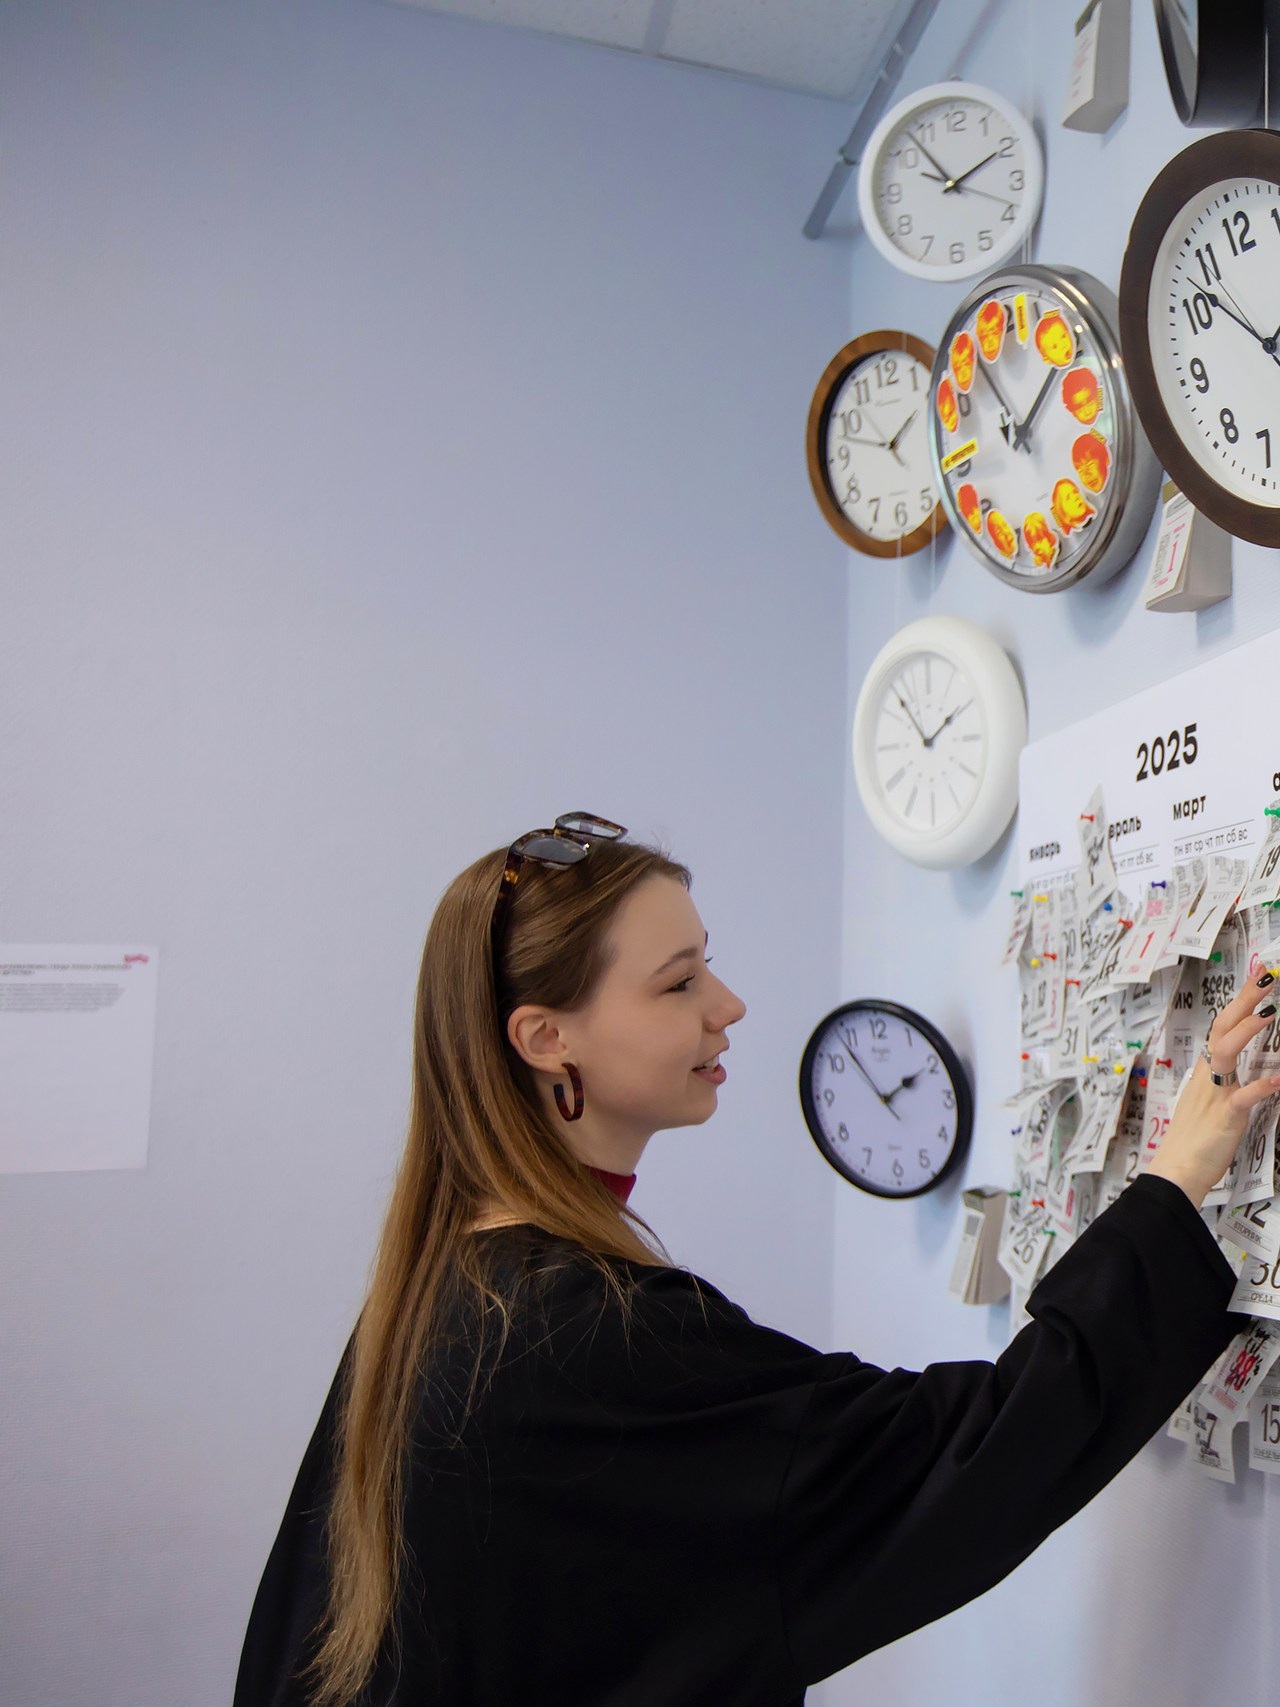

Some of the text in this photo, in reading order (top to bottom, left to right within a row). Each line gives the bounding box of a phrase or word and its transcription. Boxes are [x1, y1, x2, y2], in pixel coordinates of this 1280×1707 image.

[942, 110, 967, 132] 12
[978, 116, 989, 137] 1
[916, 122, 936, 143] 11
[999, 136, 1016, 158] 2
[896, 148, 919, 169] 10
[1009, 170, 1025, 191] 3
[886, 183, 902, 204] 9
[897, 214, 912, 235] 8
[1000, 204, 1015, 225] 4
[977, 230, 993, 252] 5
[1222, 210, 1257, 257] 12
[920, 235, 935, 259] 7
[950, 242, 965, 263] 6
[1195, 242, 1222, 286] 11
[1182, 292, 1214, 335] 10
[873, 358, 898, 388] 12
[908, 366, 919, 391] 1
[1189, 357, 1210, 393] 9
[853, 379, 870, 406] 11
[840, 409, 862, 438] 10
[1219, 407, 1239, 444] 8
[837, 445, 850, 471] 9
[1255, 428, 1271, 469] 7
[845, 472, 861, 504] 8
[868, 497, 881, 524] 7
[920, 487, 933, 512] 5
[893, 502, 907, 527] 6
[1136, 723, 1199, 783] 2025
[1173, 795, 1207, 821] март
[1107, 816, 1142, 842] враль
[1029, 841, 1061, 862] январь
[1174, 827, 1249, 856] пн вт ср чт пт сб вс
[1136, 851, 1145, 866] сб
[845, 1028, 858, 1047] 11
[869, 1018, 887, 1039] 12
[904, 1027, 913, 1047] 1
[827, 1052, 845, 1074] 10
[927, 1054, 939, 1075] 2
[823, 1088, 835, 1108] 9
[942, 1089, 955, 1110] 3
[838, 1122, 850, 1142] 8
[938, 1124, 948, 1143] 4
[862, 1147, 872, 1167] 7
[892, 1158, 904, 1178] 6
[918, 1149, 931, 1169] 5
[1232, 1221, 1263, 1244] ВТОРНИК
[1250, 1292, 1273, 1304] СРЕДА
